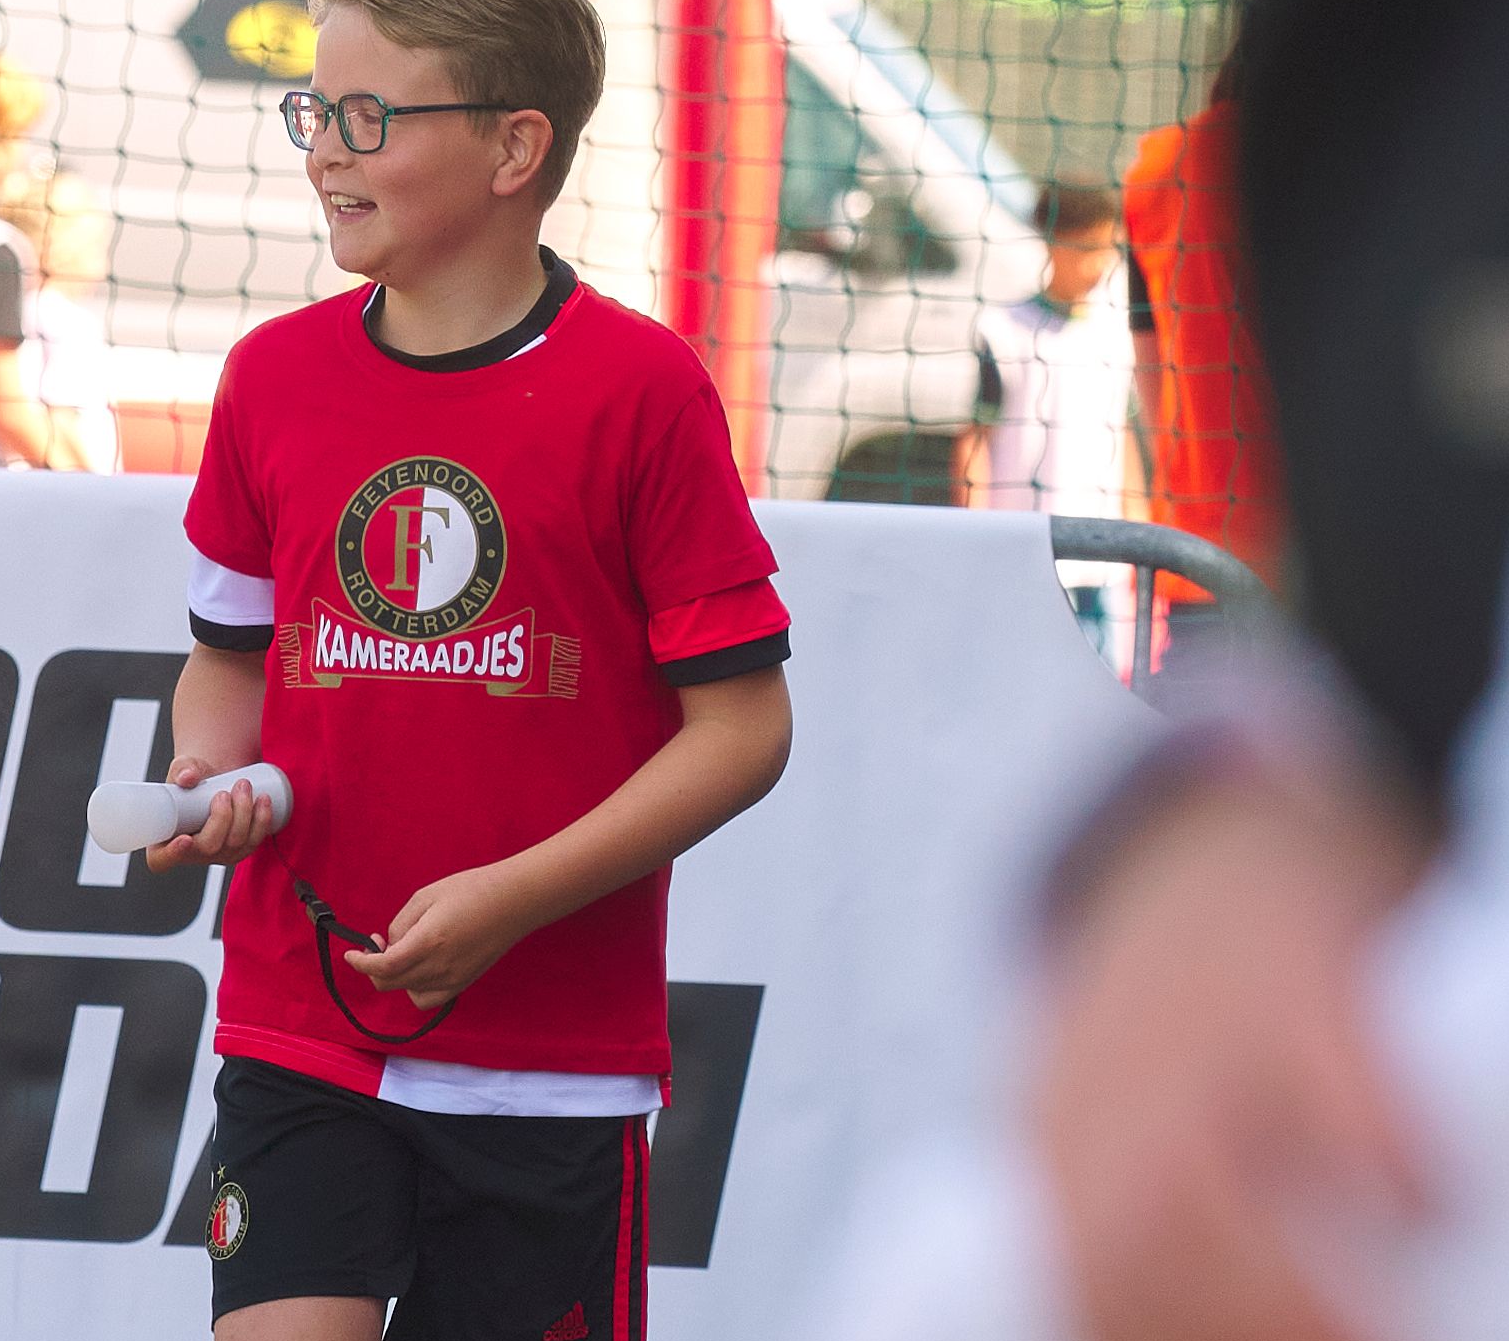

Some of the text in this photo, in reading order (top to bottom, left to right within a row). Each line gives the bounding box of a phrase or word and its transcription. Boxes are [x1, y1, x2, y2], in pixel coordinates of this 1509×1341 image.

[351, 462, 494, 526] FEYENOORD
[385, 504, 450, 591] F
[346, 570, 493, 635] ROTTERDAM
[315, 612, 525, 678] KAMERAADJES
